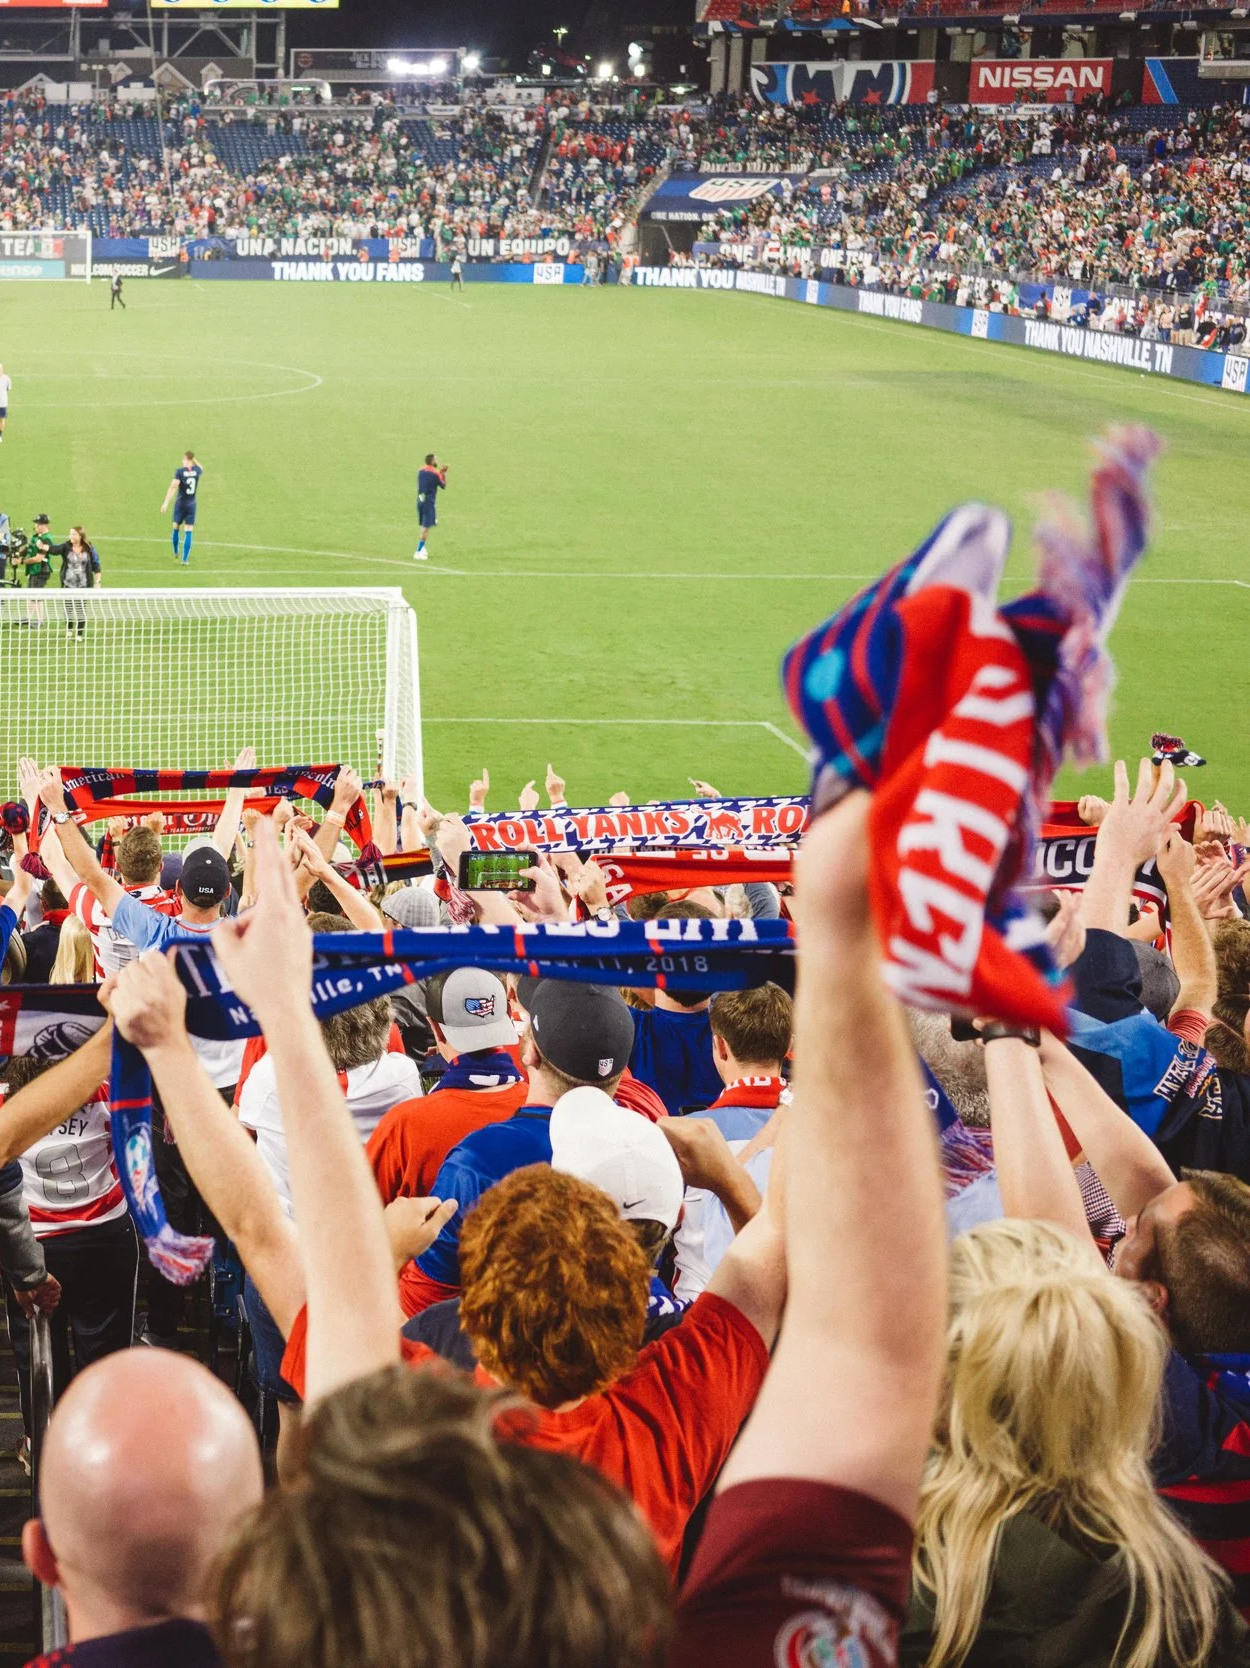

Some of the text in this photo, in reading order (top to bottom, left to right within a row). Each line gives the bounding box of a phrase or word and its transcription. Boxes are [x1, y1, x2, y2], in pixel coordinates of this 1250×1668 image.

[978, 66, 1104, 88] NISSAN
[1, 237, 35, 256] TEA
[467, 237, 571, 257] UN EQUIPO
[271, 262, 425, 282] THANK YOU FANS
[535, 264, 562, 281] USA
[634, 267, 698, 288] THANK
[700, 268, 735, 289] YOU
[1024, 319, 1174, 374] THANK YOU NASHVILLE, TN
[1225, 357, 1247, 386] USA
[185, 477, 196, 495] 3
[468, 804, 808, 852] ROLL YANKS RO
[198, 886, 215, 894] USA
[645, 954, 711, 975] 2018
[35, 1142, 90, 1205] 8
